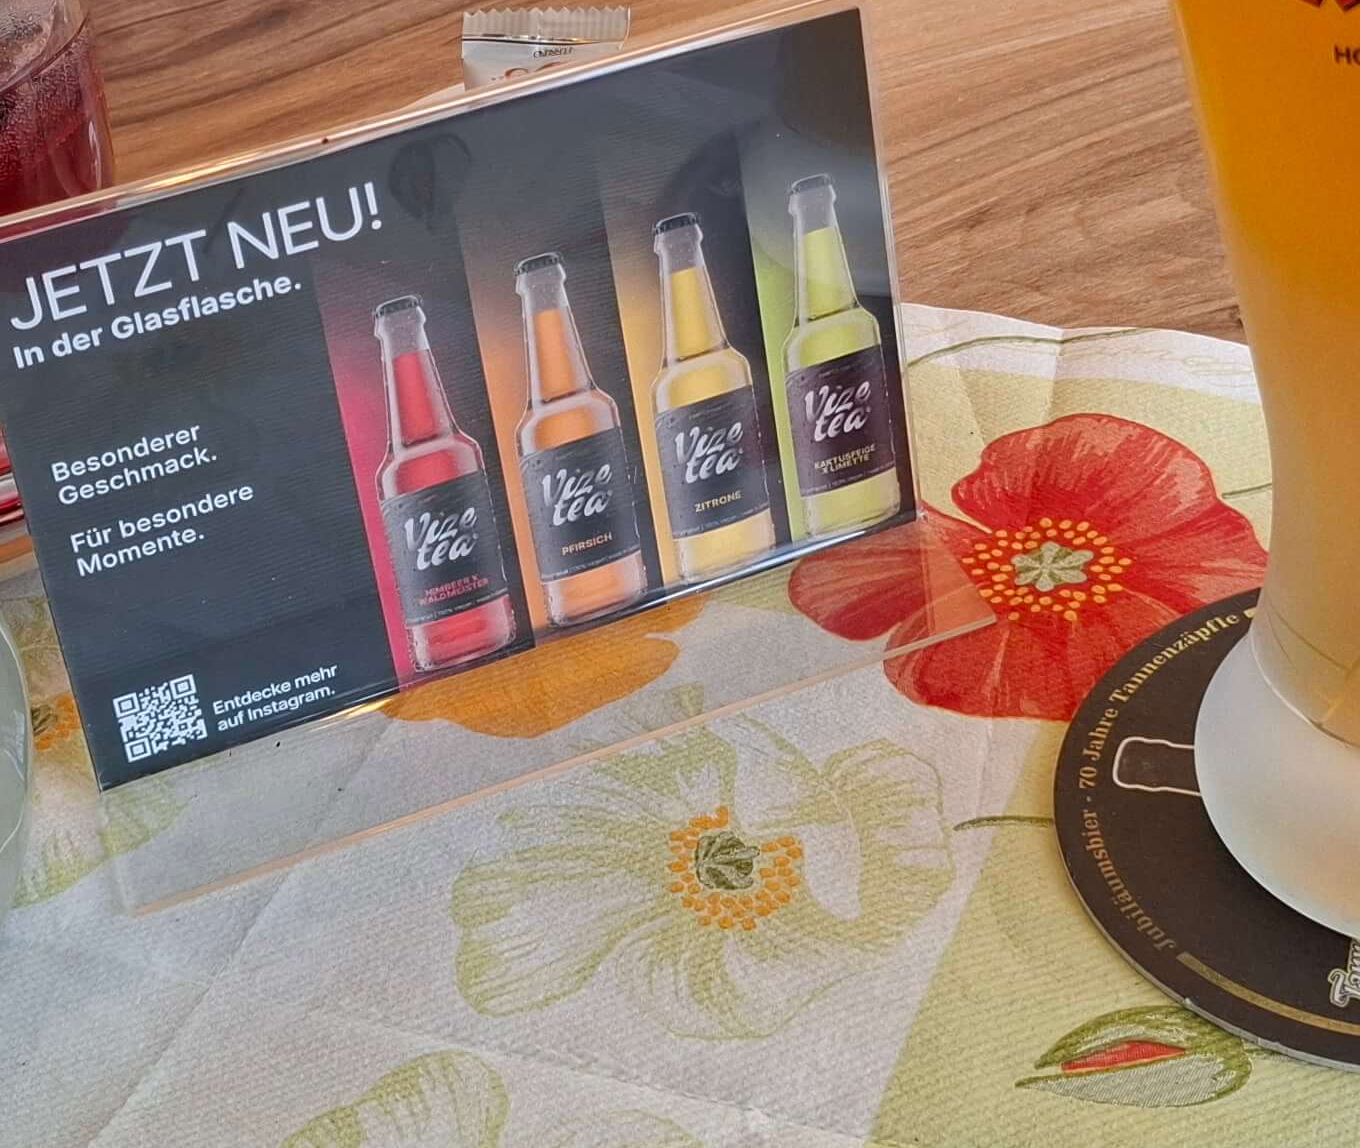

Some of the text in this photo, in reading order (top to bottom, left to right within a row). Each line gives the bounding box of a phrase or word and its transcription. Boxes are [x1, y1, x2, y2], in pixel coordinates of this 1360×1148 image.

[10, 181, 383, 331] JETZT NEU!
[13, 273, 302, 370] In der Glasflasche.
[804, 381, 871, 423] Vize
[51, 424, 201, 483] Besonderer
[675, 421, 743, 464] Vize
[57, 446, 218, 505] Geschmack.
[542, 464, 613, 507] Vize
[70, 485, 254, 553] Für besondere
[694, 490, 742, 513] ZITRONE
[76, 525, 205, 577] Momente.
[404, 507, 477, 550] Vize
[561, 532, 613, 556] PFIRSICH
[1109, 613, 1241, 704] Tannenzäpfle
[212, 664, 338, 715] Entdecke mehr
[217, 686, 336, 732] auf Instagram.
[1081, 707, 1119, 761] Jahre
[1078, 766, 1097, 790] 70
[1081, 809, 1177, 950] Jubiläumsbier
